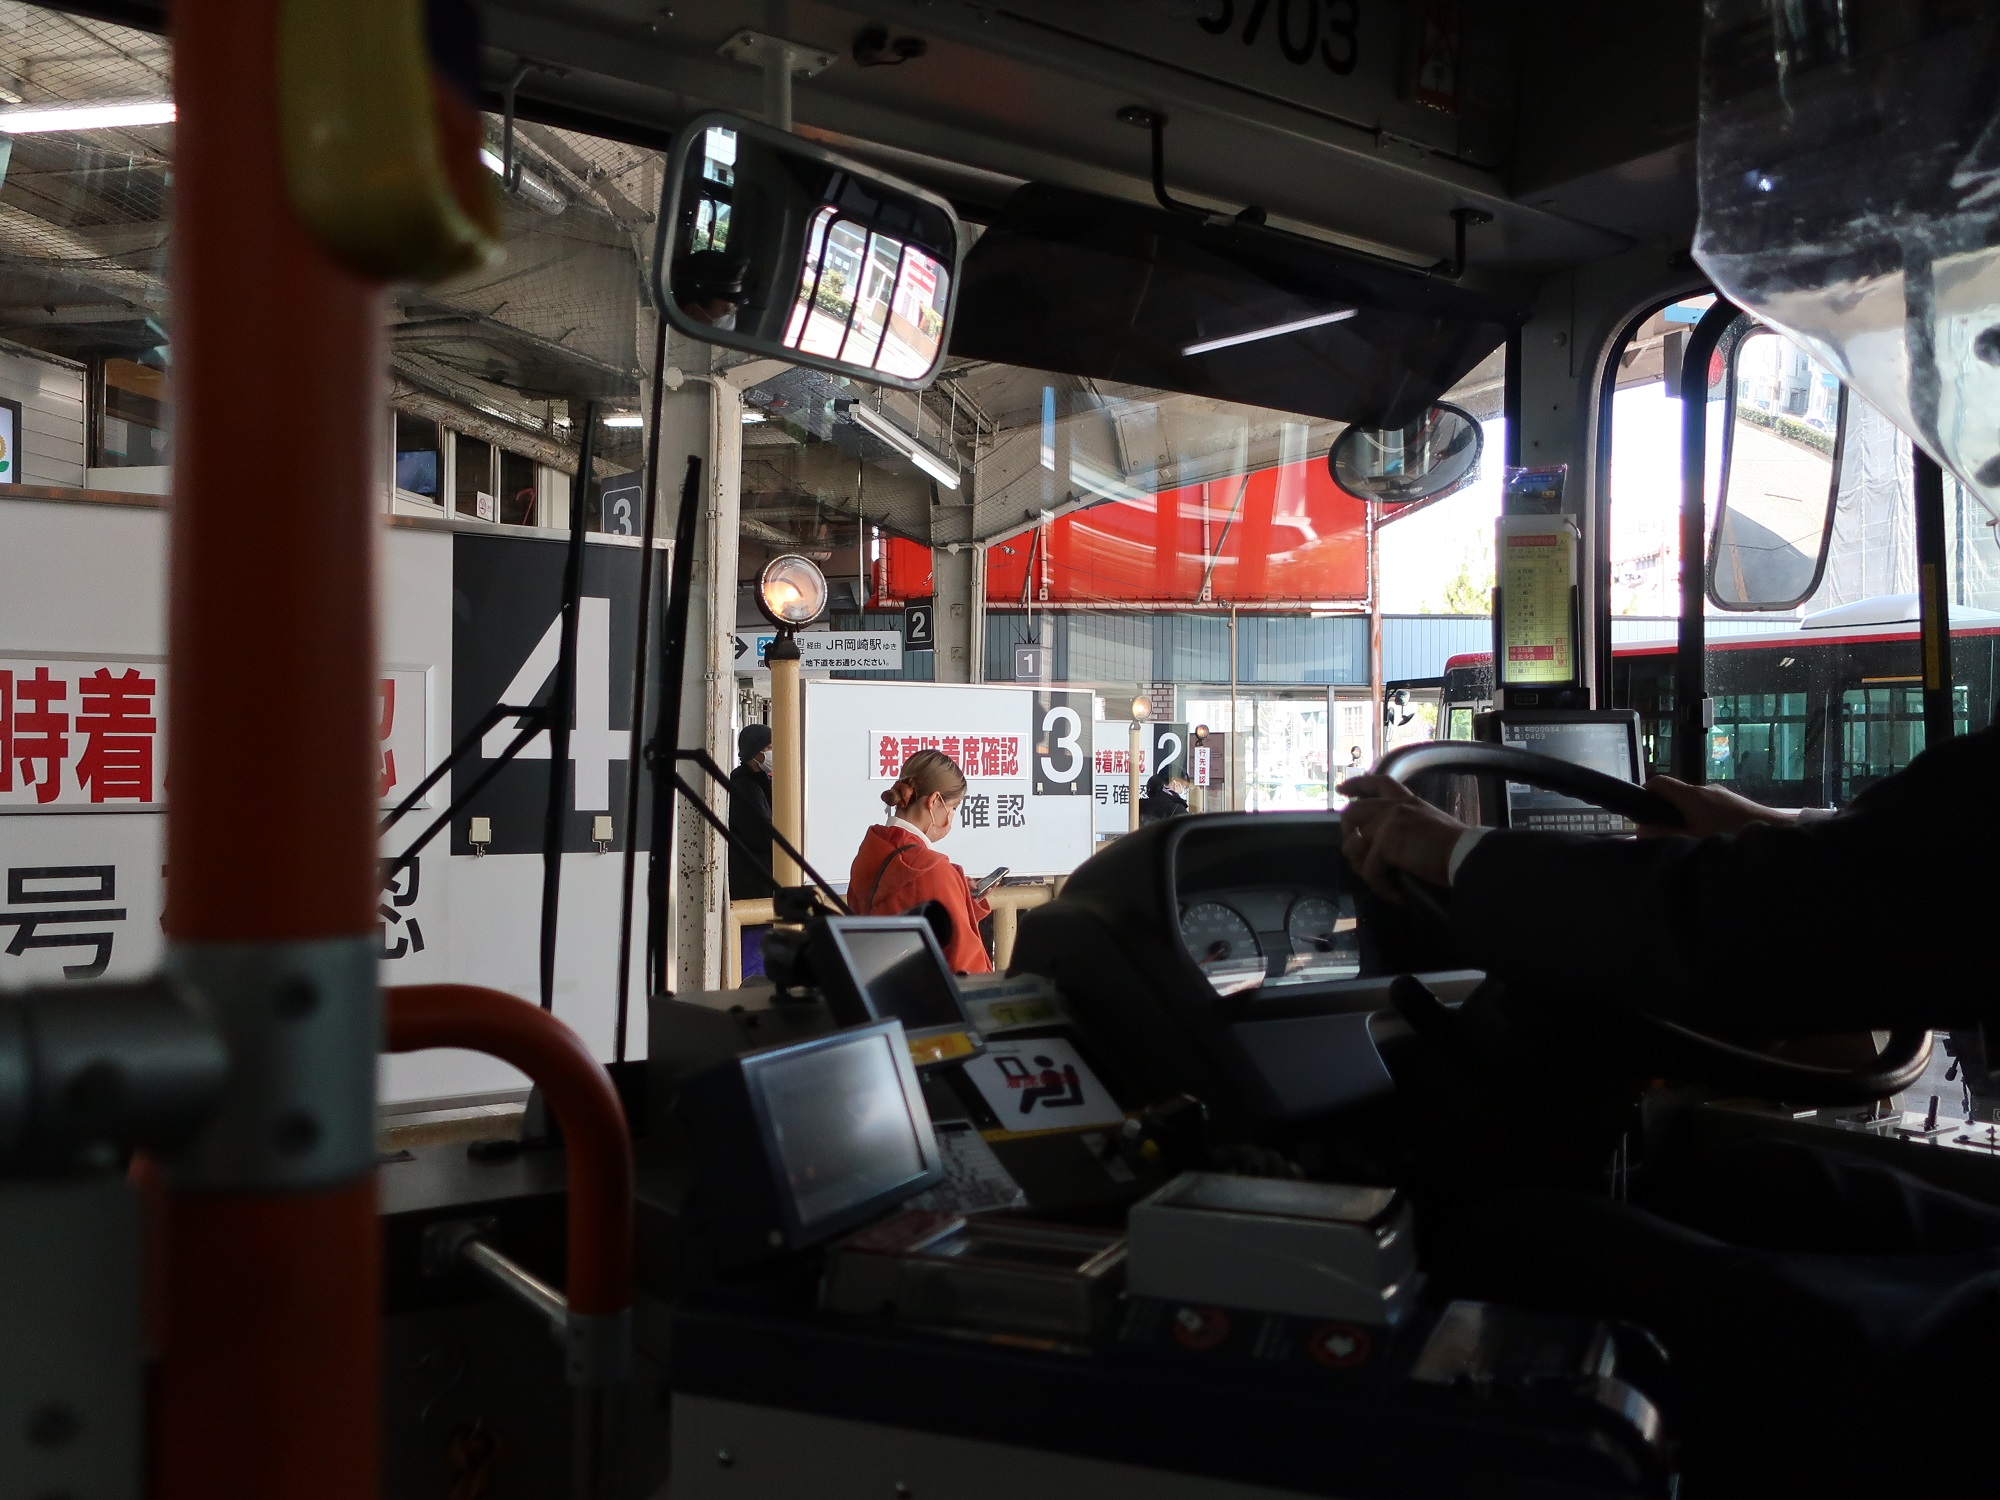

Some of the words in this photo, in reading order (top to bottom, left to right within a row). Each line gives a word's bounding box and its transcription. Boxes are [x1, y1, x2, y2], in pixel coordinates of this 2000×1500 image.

[611, 498, 633, 537] 3
[911, 612, 926, 638] 2
[806, 641, 822, 650] 経由
[1023, 653, 1033, 673] 1
[481, 596, 631, 811] 4
[1040, 706, 1084, 783] 3
[1157, 732, 1182, 775] 2
